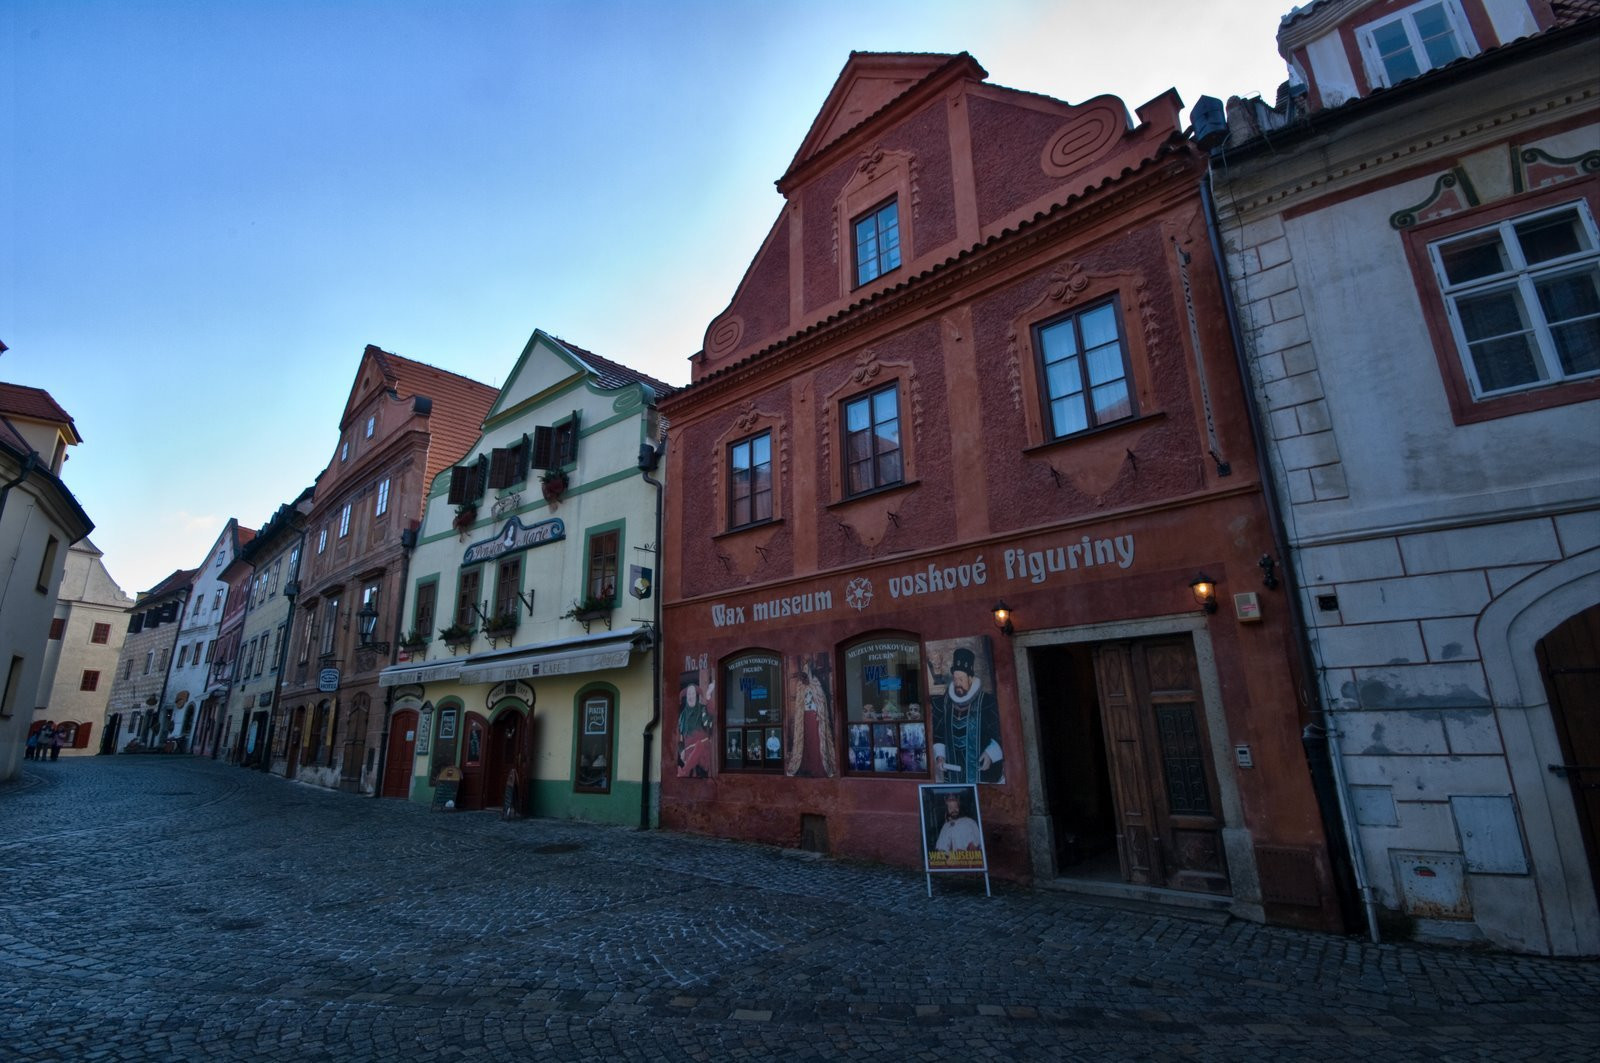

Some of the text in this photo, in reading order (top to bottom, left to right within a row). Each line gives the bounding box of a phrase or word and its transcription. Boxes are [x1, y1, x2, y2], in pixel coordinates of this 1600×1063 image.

[888, 534, 1135, 599] voskové figuriny
[711, 590, 833, 628] Wax museum
[847, 645, 874, 658] MUZEUM
[685, 655, 698, 672] No.
[949, 850, 983, 861] MUSEUM
